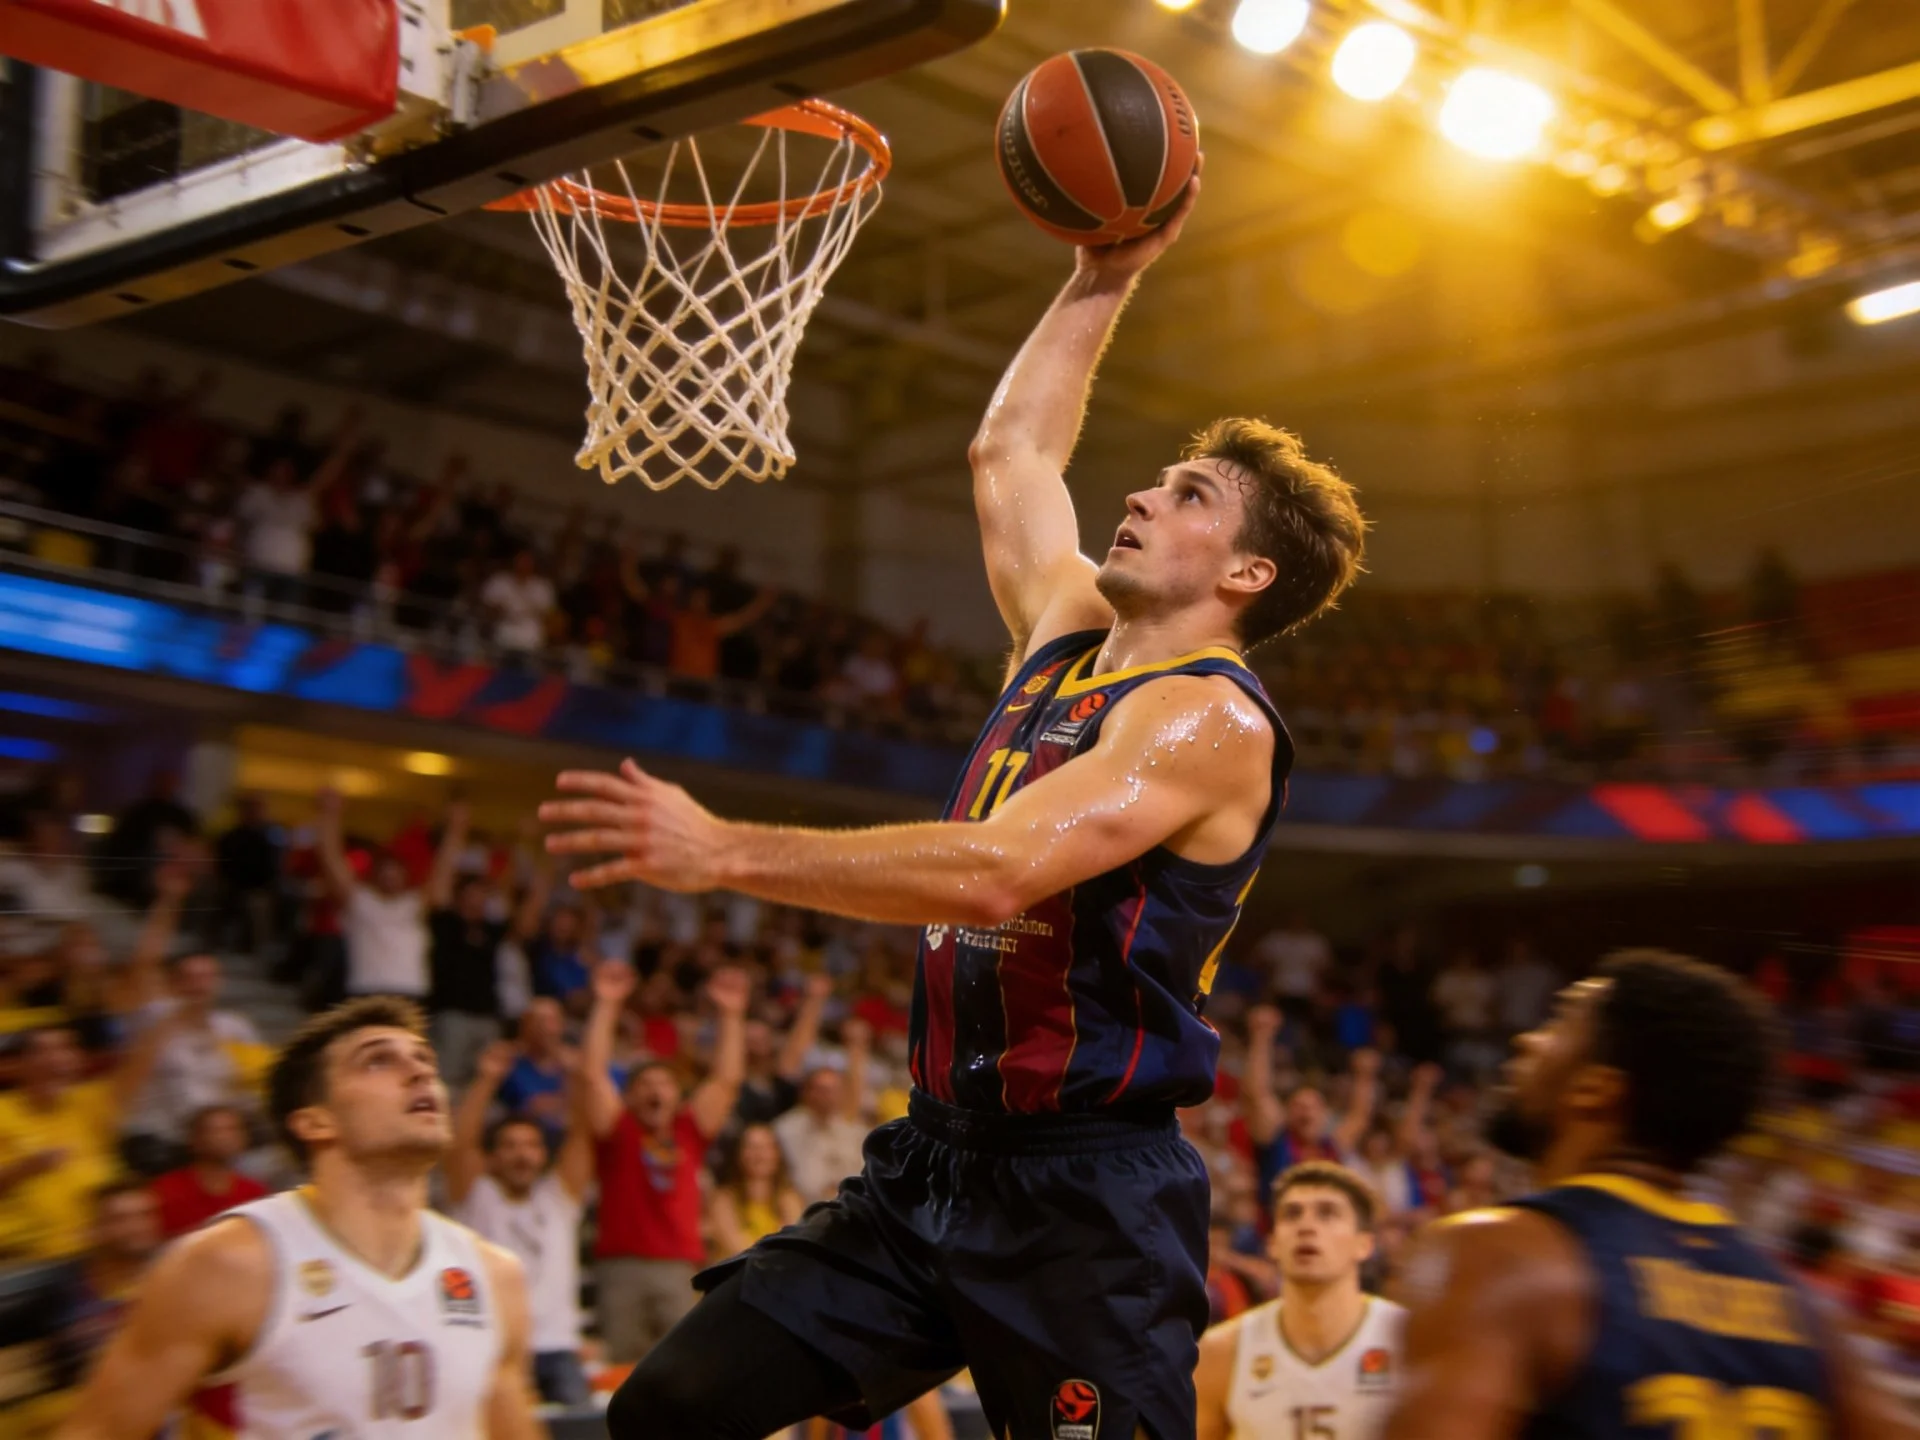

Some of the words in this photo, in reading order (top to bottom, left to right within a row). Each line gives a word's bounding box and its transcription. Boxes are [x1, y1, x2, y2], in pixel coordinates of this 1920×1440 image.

[968, 747, 1030, 819] 11
[359, 1339, 438, 1421] 10
[1290, 1406, 1337, 1440] 15
